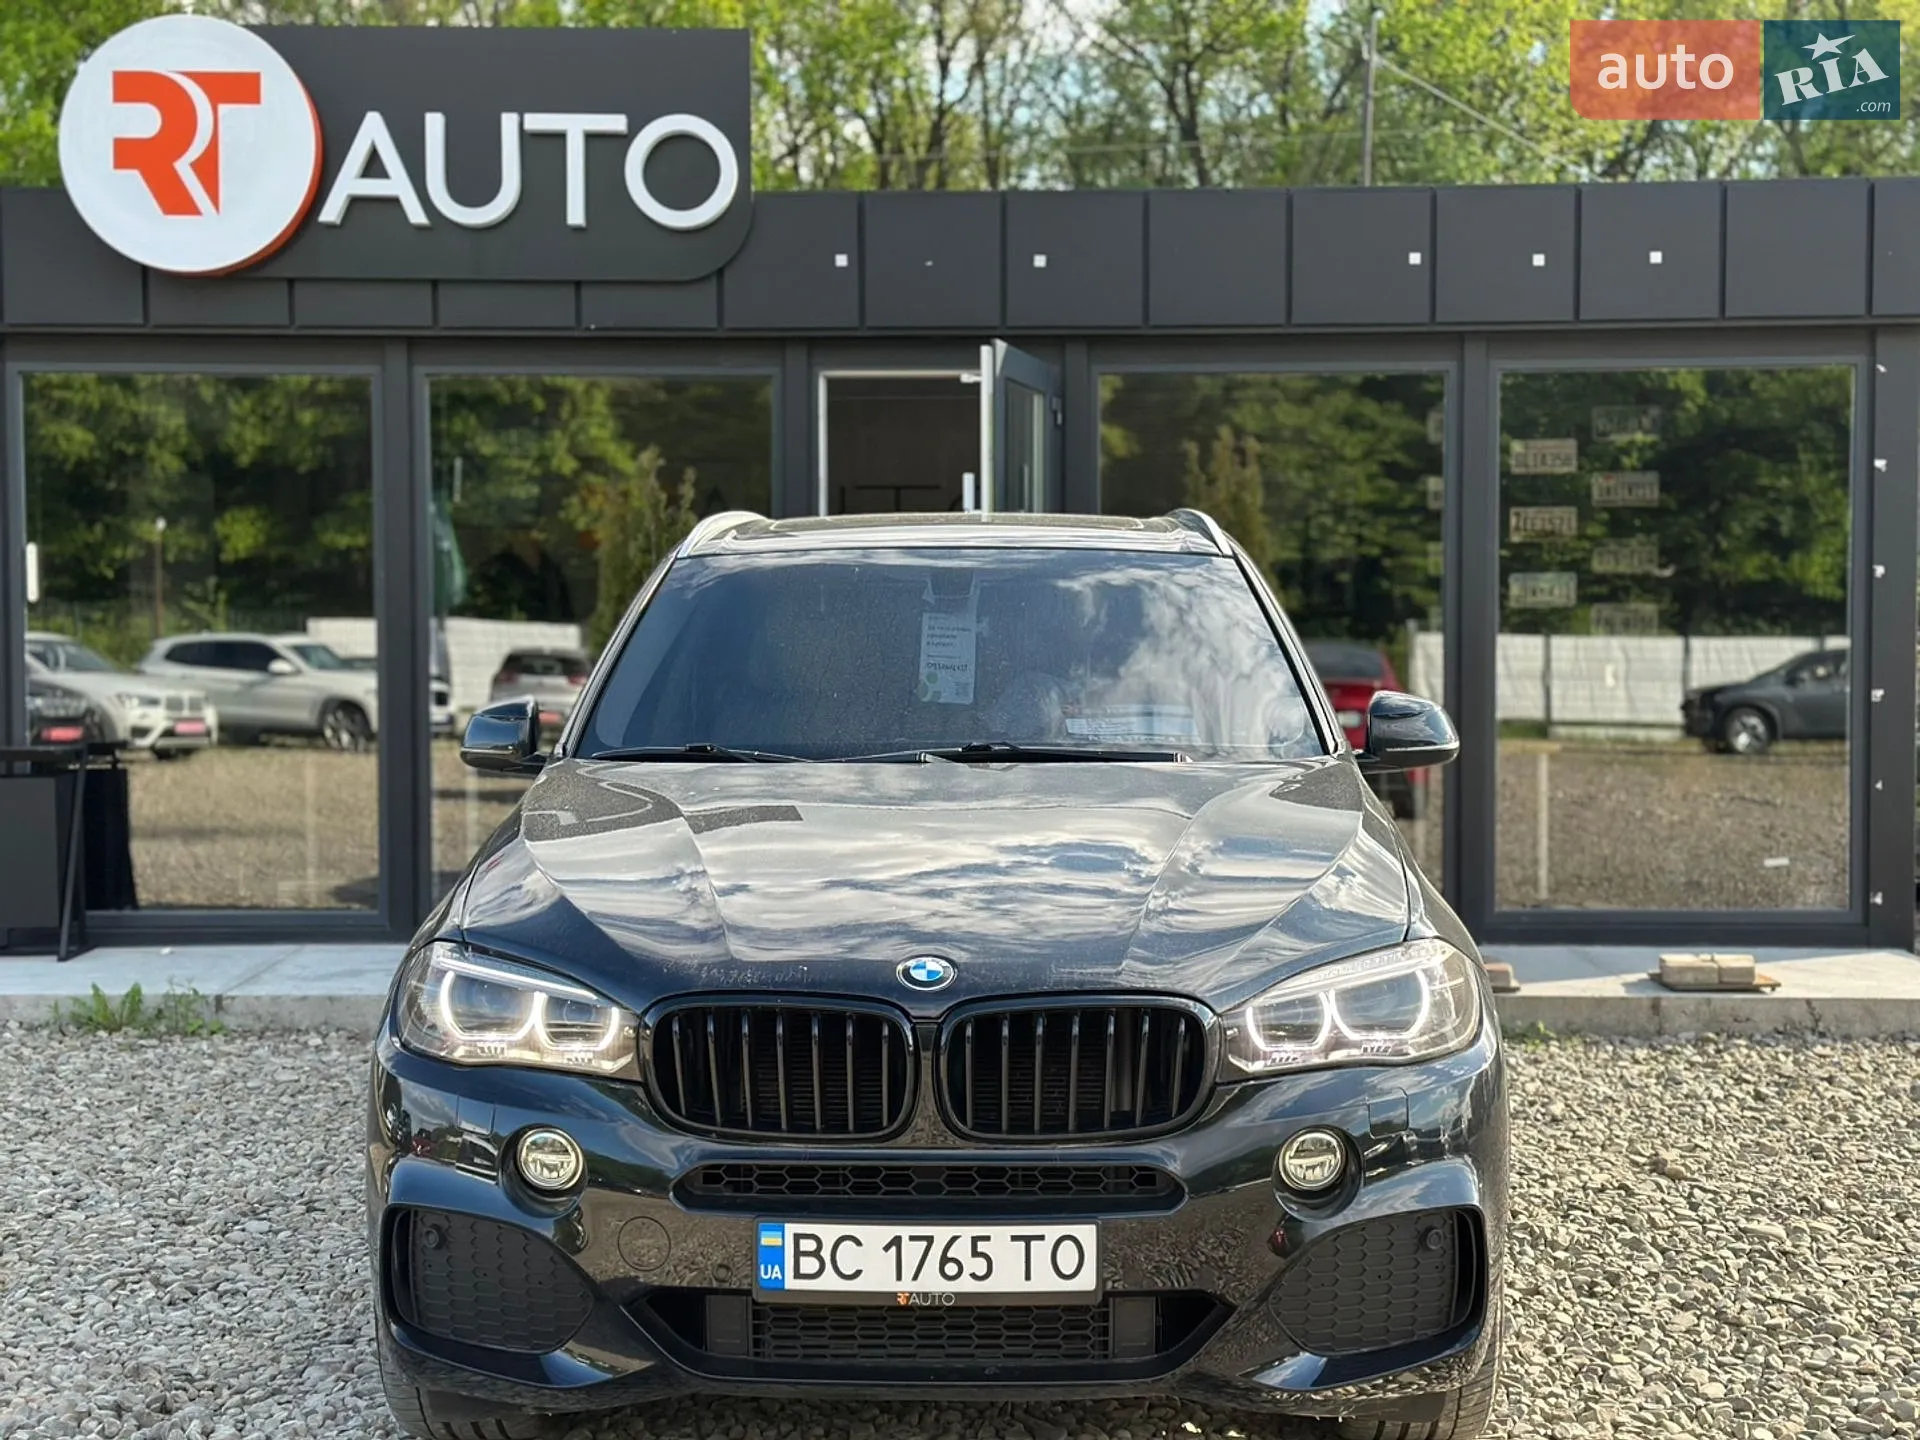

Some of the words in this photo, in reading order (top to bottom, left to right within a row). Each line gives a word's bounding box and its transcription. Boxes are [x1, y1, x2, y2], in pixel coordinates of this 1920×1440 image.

[112, 70, 261, 216] RT
[318, 111, 739, 231] AUTO
[760, 1264, 782, 1280] UA
[793, 1233, 863, 1281] BC
[882, 1235, 993, 1281] 1765
[1010, 1234, 1085, 1281] TO
[909, 1292, 956, 1306] AUTO
